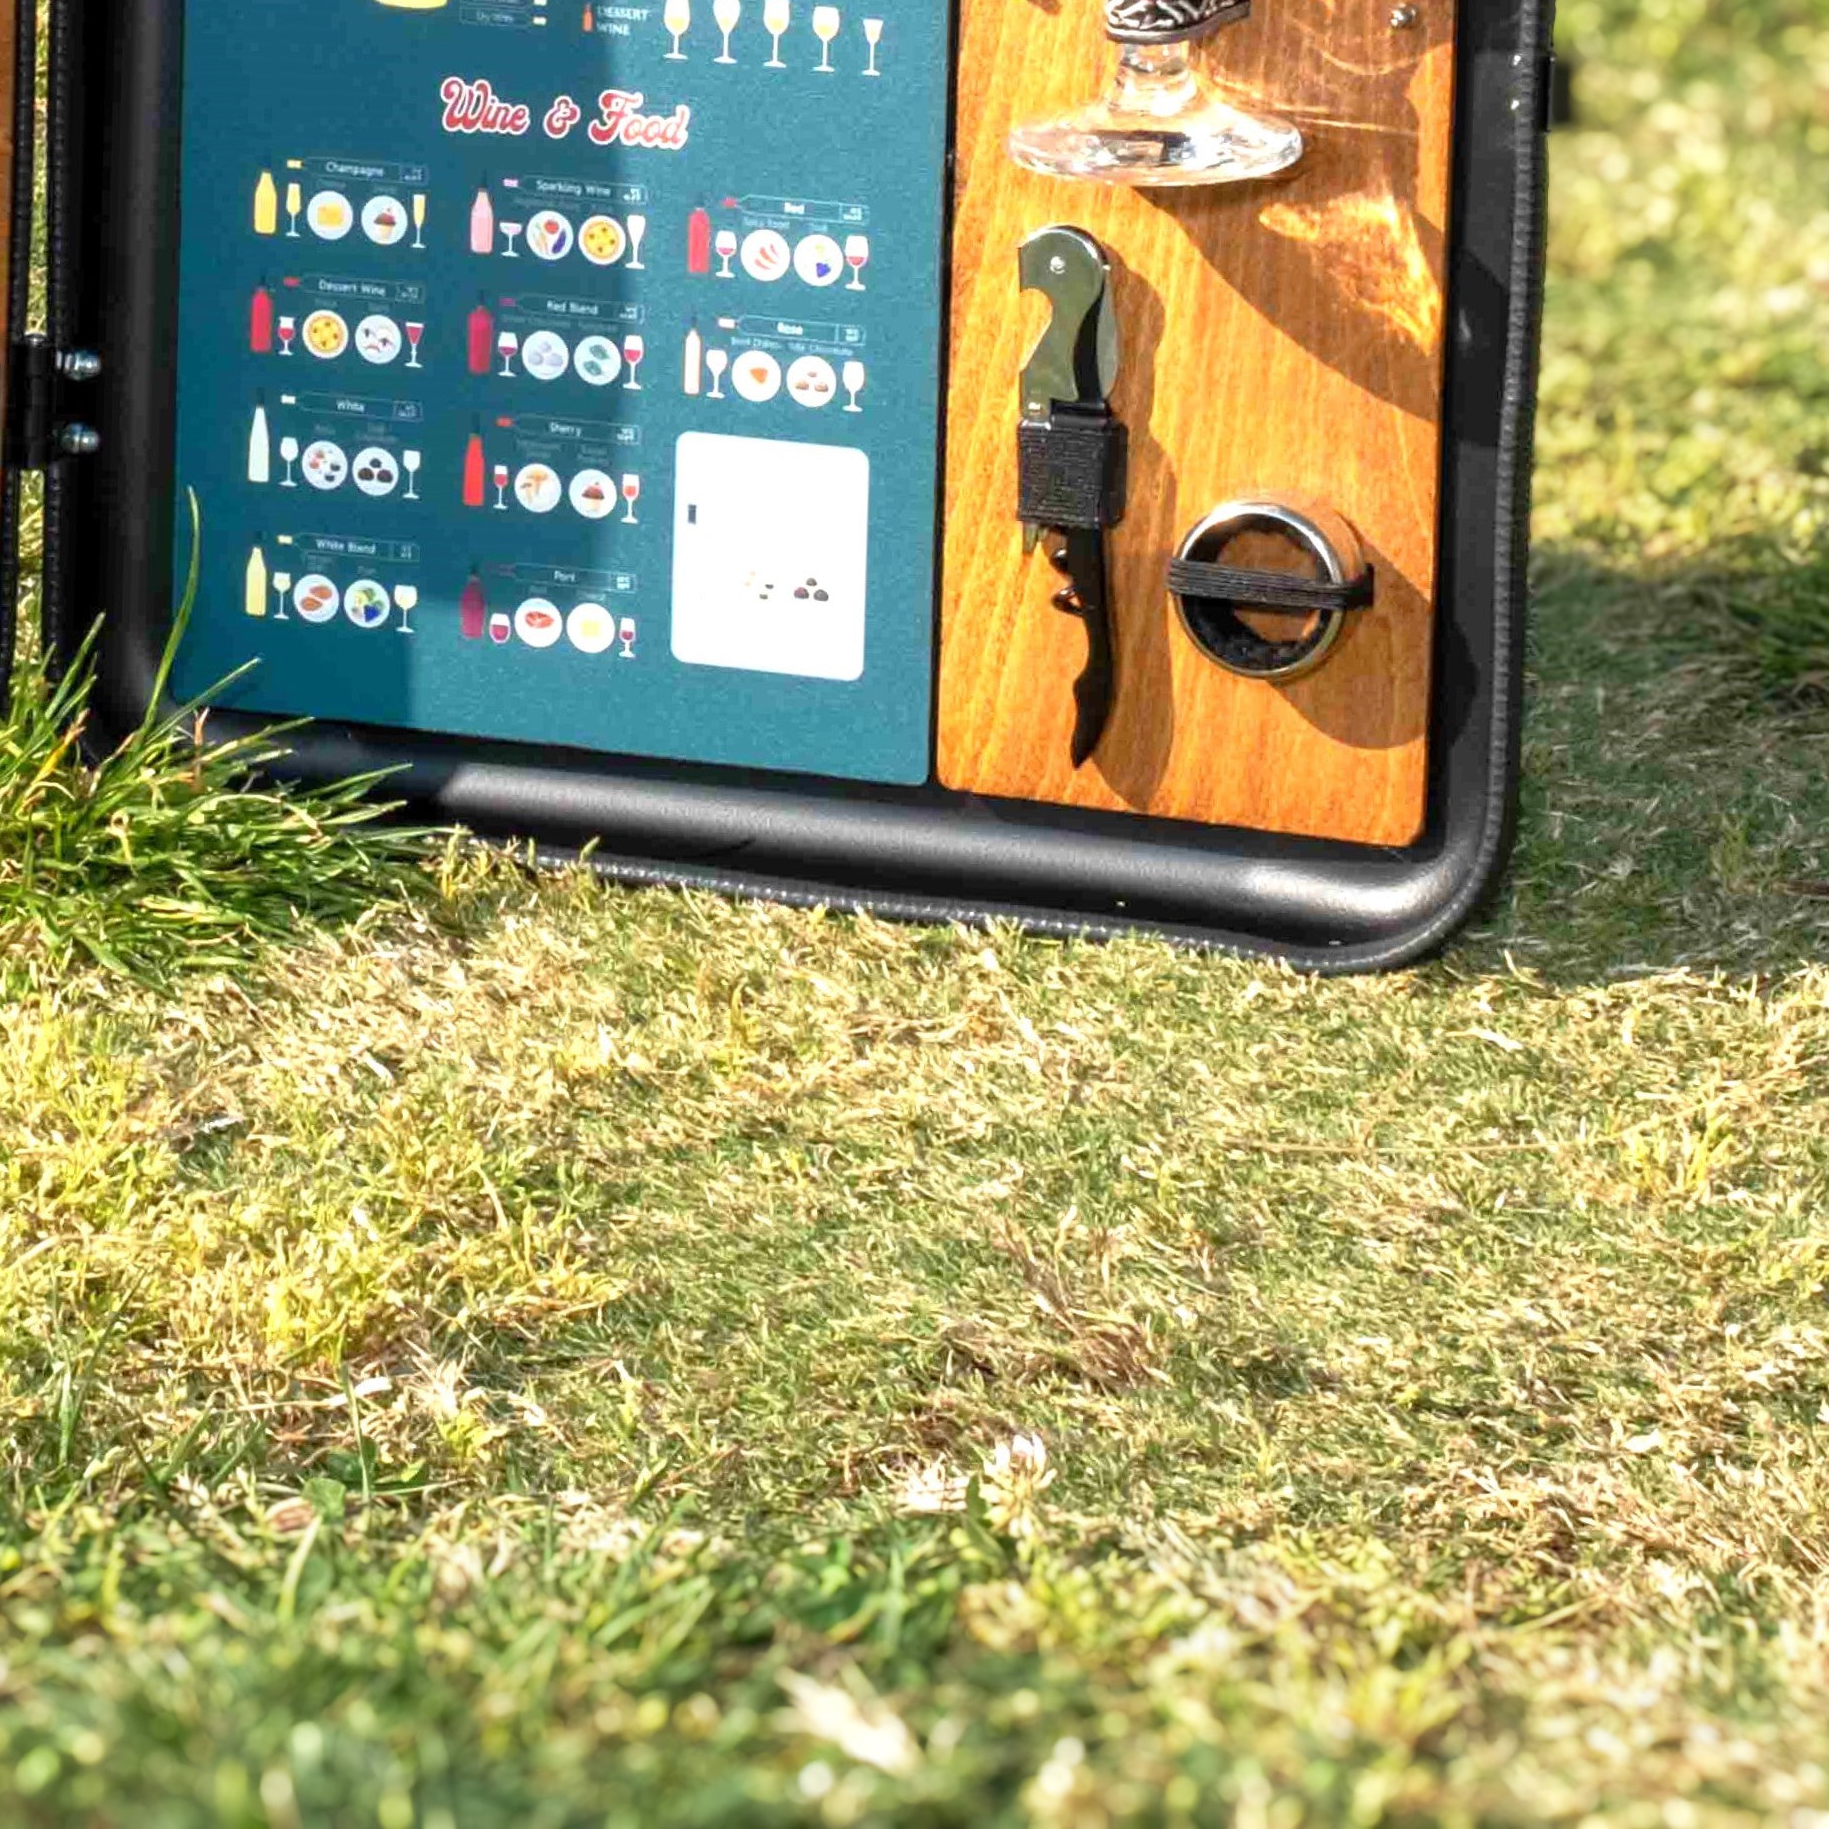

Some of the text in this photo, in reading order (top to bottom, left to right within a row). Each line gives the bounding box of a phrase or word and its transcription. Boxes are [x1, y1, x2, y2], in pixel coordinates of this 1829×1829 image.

[597, 6, 651, 20] DESSERT
[596, 23, 629, 35] WINE
[440, 76, 689, 151] Wine & Food
[326, 161, 383, 179] Champagne
[536, 179, 582, 196] Sparkling
[319, 279, 385, 296] Dessert Wine
